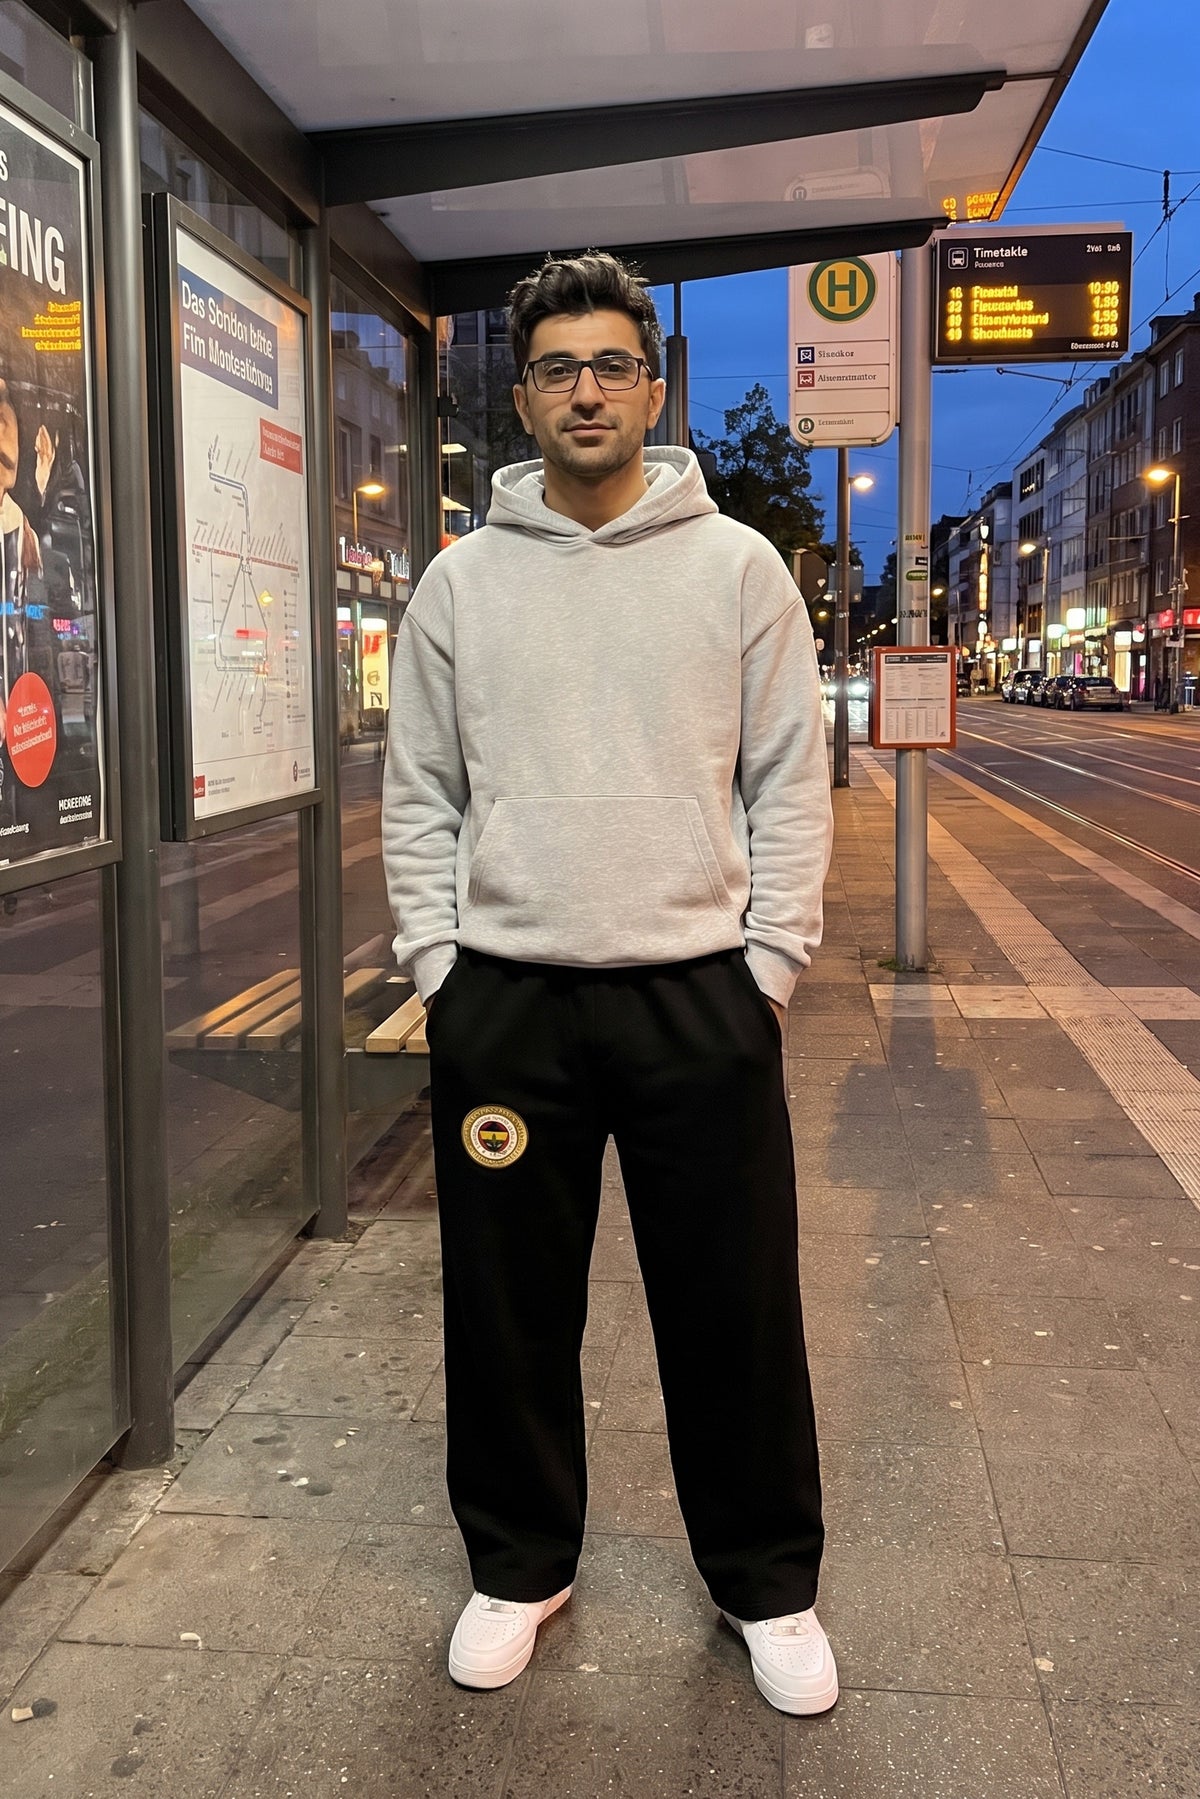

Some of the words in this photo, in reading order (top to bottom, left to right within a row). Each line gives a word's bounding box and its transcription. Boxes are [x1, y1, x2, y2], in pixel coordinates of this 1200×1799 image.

[973, 246, 1028, 258] Timetakle
[181, 279, 206, 319] Das
[827, 269, 857, 308] H
